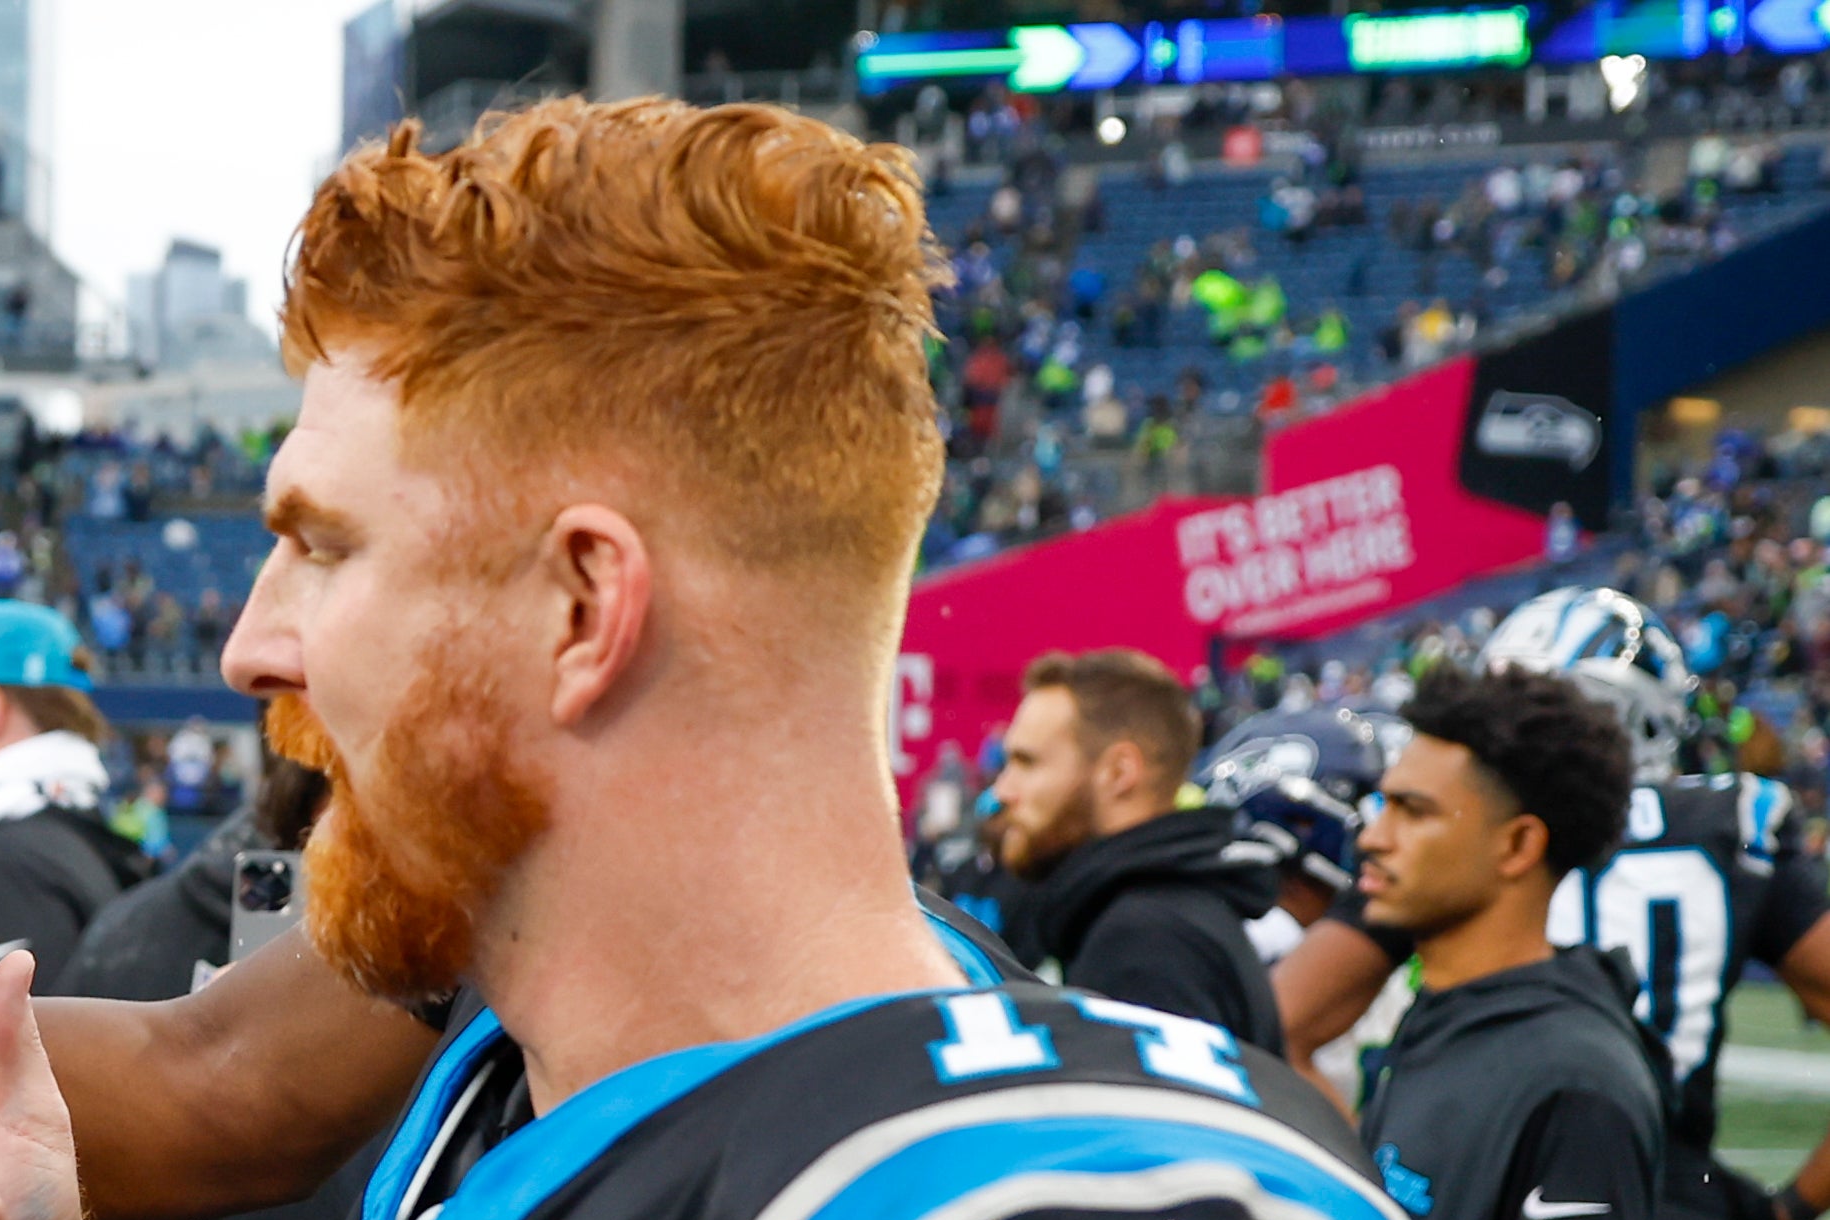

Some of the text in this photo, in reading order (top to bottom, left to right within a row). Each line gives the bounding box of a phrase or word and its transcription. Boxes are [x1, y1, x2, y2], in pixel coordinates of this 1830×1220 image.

[1177, 464, 1403, 567] IT'S BETTER
[1185, 545, 1301, 622] OVER
[1303, 513, 1413, 585] HERE
